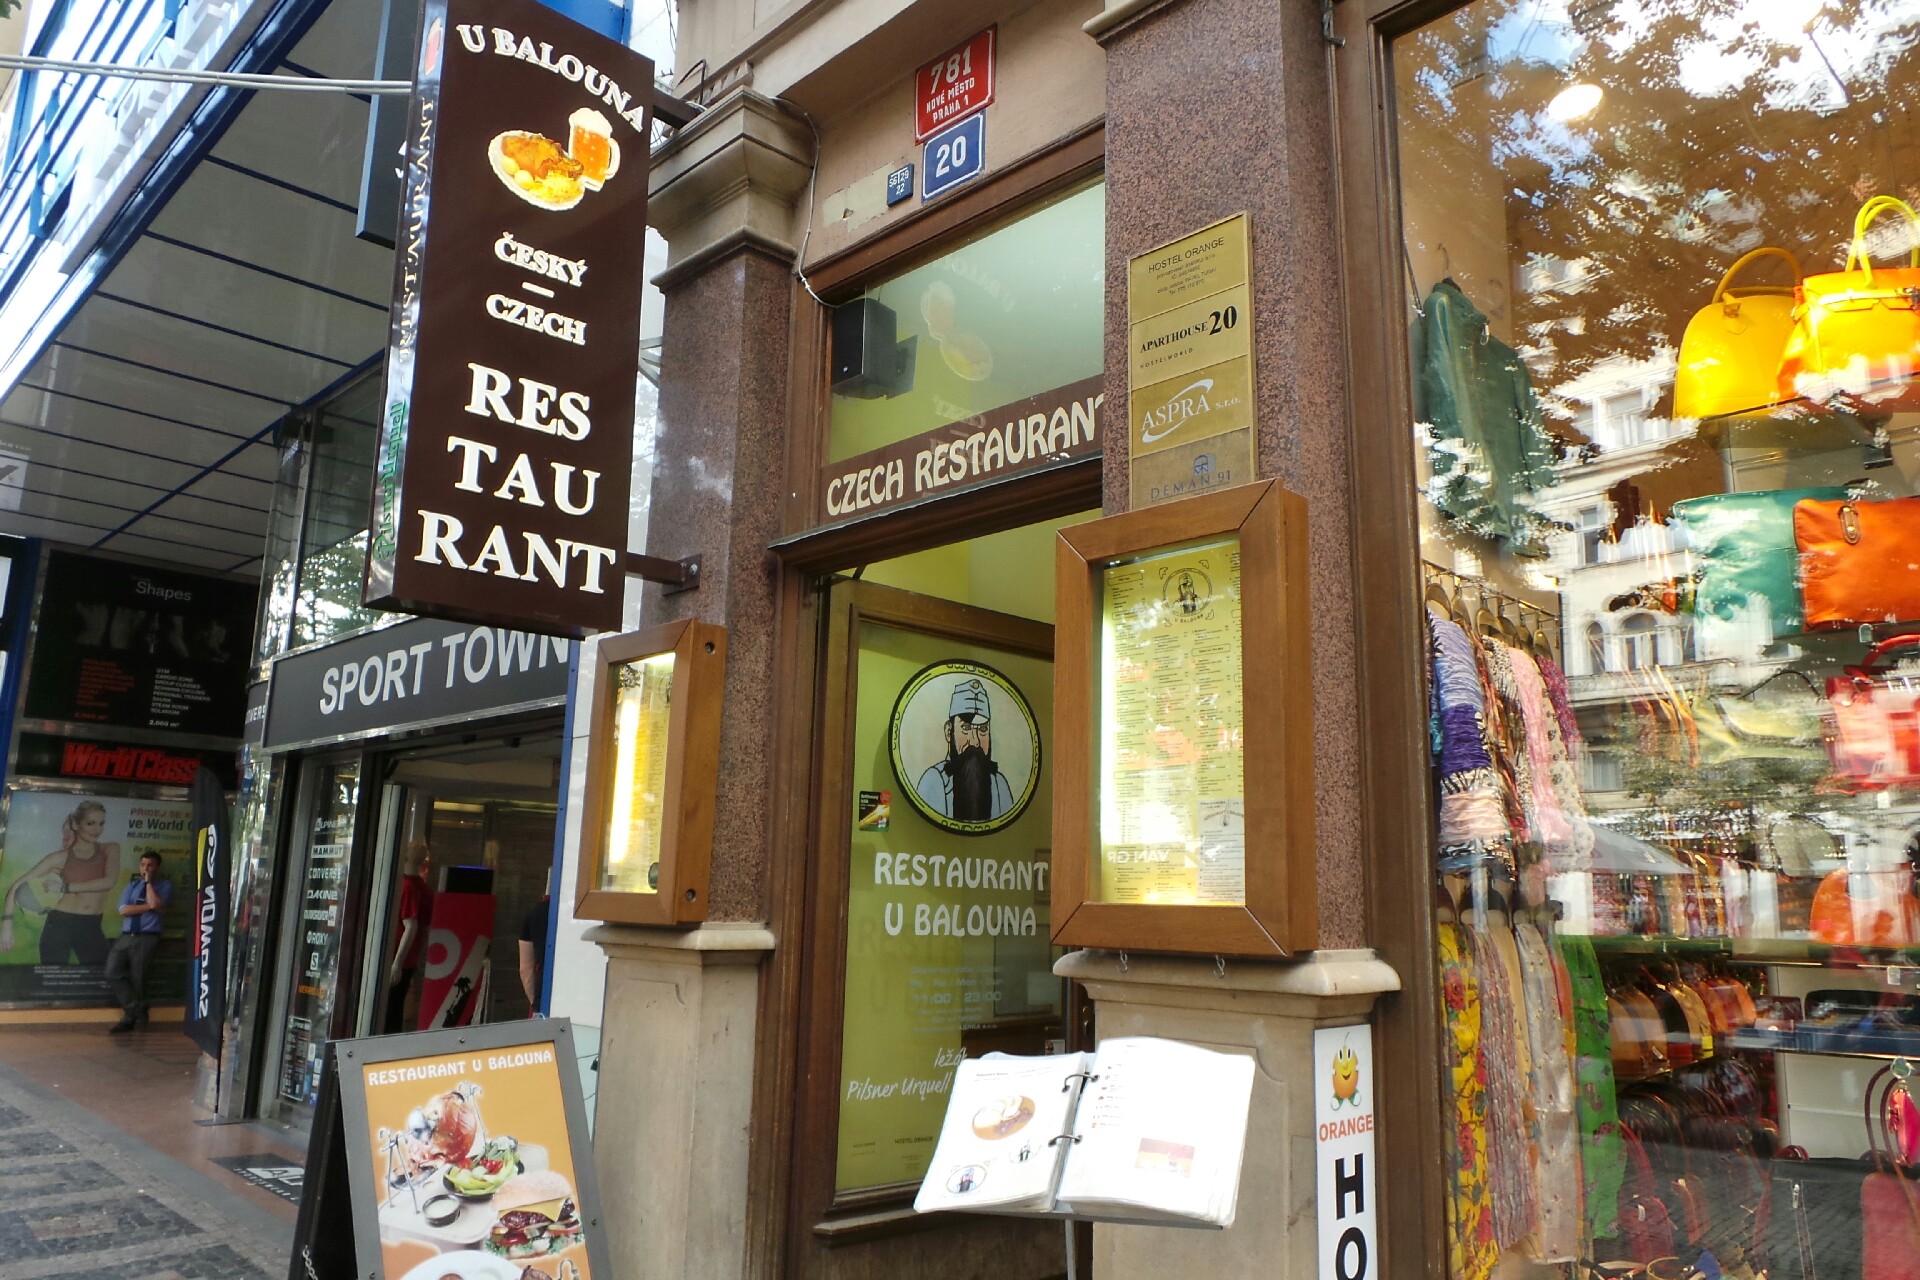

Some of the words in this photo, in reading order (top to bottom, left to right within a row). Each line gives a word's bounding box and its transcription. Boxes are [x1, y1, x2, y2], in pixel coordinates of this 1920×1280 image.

[456, 24, 486, 53] U
[491, 27, 645, 133] BALOUNA
[930, 45, 973, 94] 781
[926, 90, 945, 113] NOVÉ
[947, 76, 975, 100] MĚSTO
[932, 101, 961, 123] PRAHA
[963, 94, 970, 107] 1
[935, 134, 966, 178] 20
[494, 231, 589, 287] ČESKÝ
[1148, 254, 1183, 273] HOSTEL
[1184, 237, 1224, 259] ORANGE
[485, 293, 588, 346] CZECH
[1140, 320, 1208, 353] APARTHOUSE
[1209, 305, 1238, 336] 20
[464, 362, 592, 441] RES
[1141, 393, 1211, 431] ASPRA
[1215, 397, 1241, 410] s.r.o.
[379, 400, 407, 480] Urquell
[826, 458, 903, 516] CZECH
[915, 392, 1104, 492] RESTAURAN
[447, 435, 601, 516] TAU
[1151, 475, 1211, 499] DEMAN
[1217, 470, 1230, 482] 91
[372, 482, 397, 561] Pilsner
[413, 509, 616, 595] RANT
[135, 581, 192, 602] Shapes
[319, 642, 432, 715] SPORT
[442, 626, 569, 688] TOWN
[64, 742, 137, 777] World
[136, 750, 200, 783] Class
[128, 819, 143, 829] ve
[147, 818, 184, 831] World
[311, 847, 344, 856] MAMMUT
[308, 867, 341, 879] CONVERSE
[874, 852, 1048, 891] RESTAURANT
[307, 889, 338, 900] DAKINE
[311, 932, 328, 945] ROXY
[884, 903, 904, 936] U
[914, 903, 1037, 937] BALOUNA
[368, 1061, 466, 1086] RESTAURANT
[472, 1059, 482, 1073] U
[488, 1050, 552, 1071] BALOUNA
[846, 1077, 898, 1101] Pilsner
[901, 1072, 952, 1101] Urquell
[1318, 1113, 1374, 1142] ORANGE
